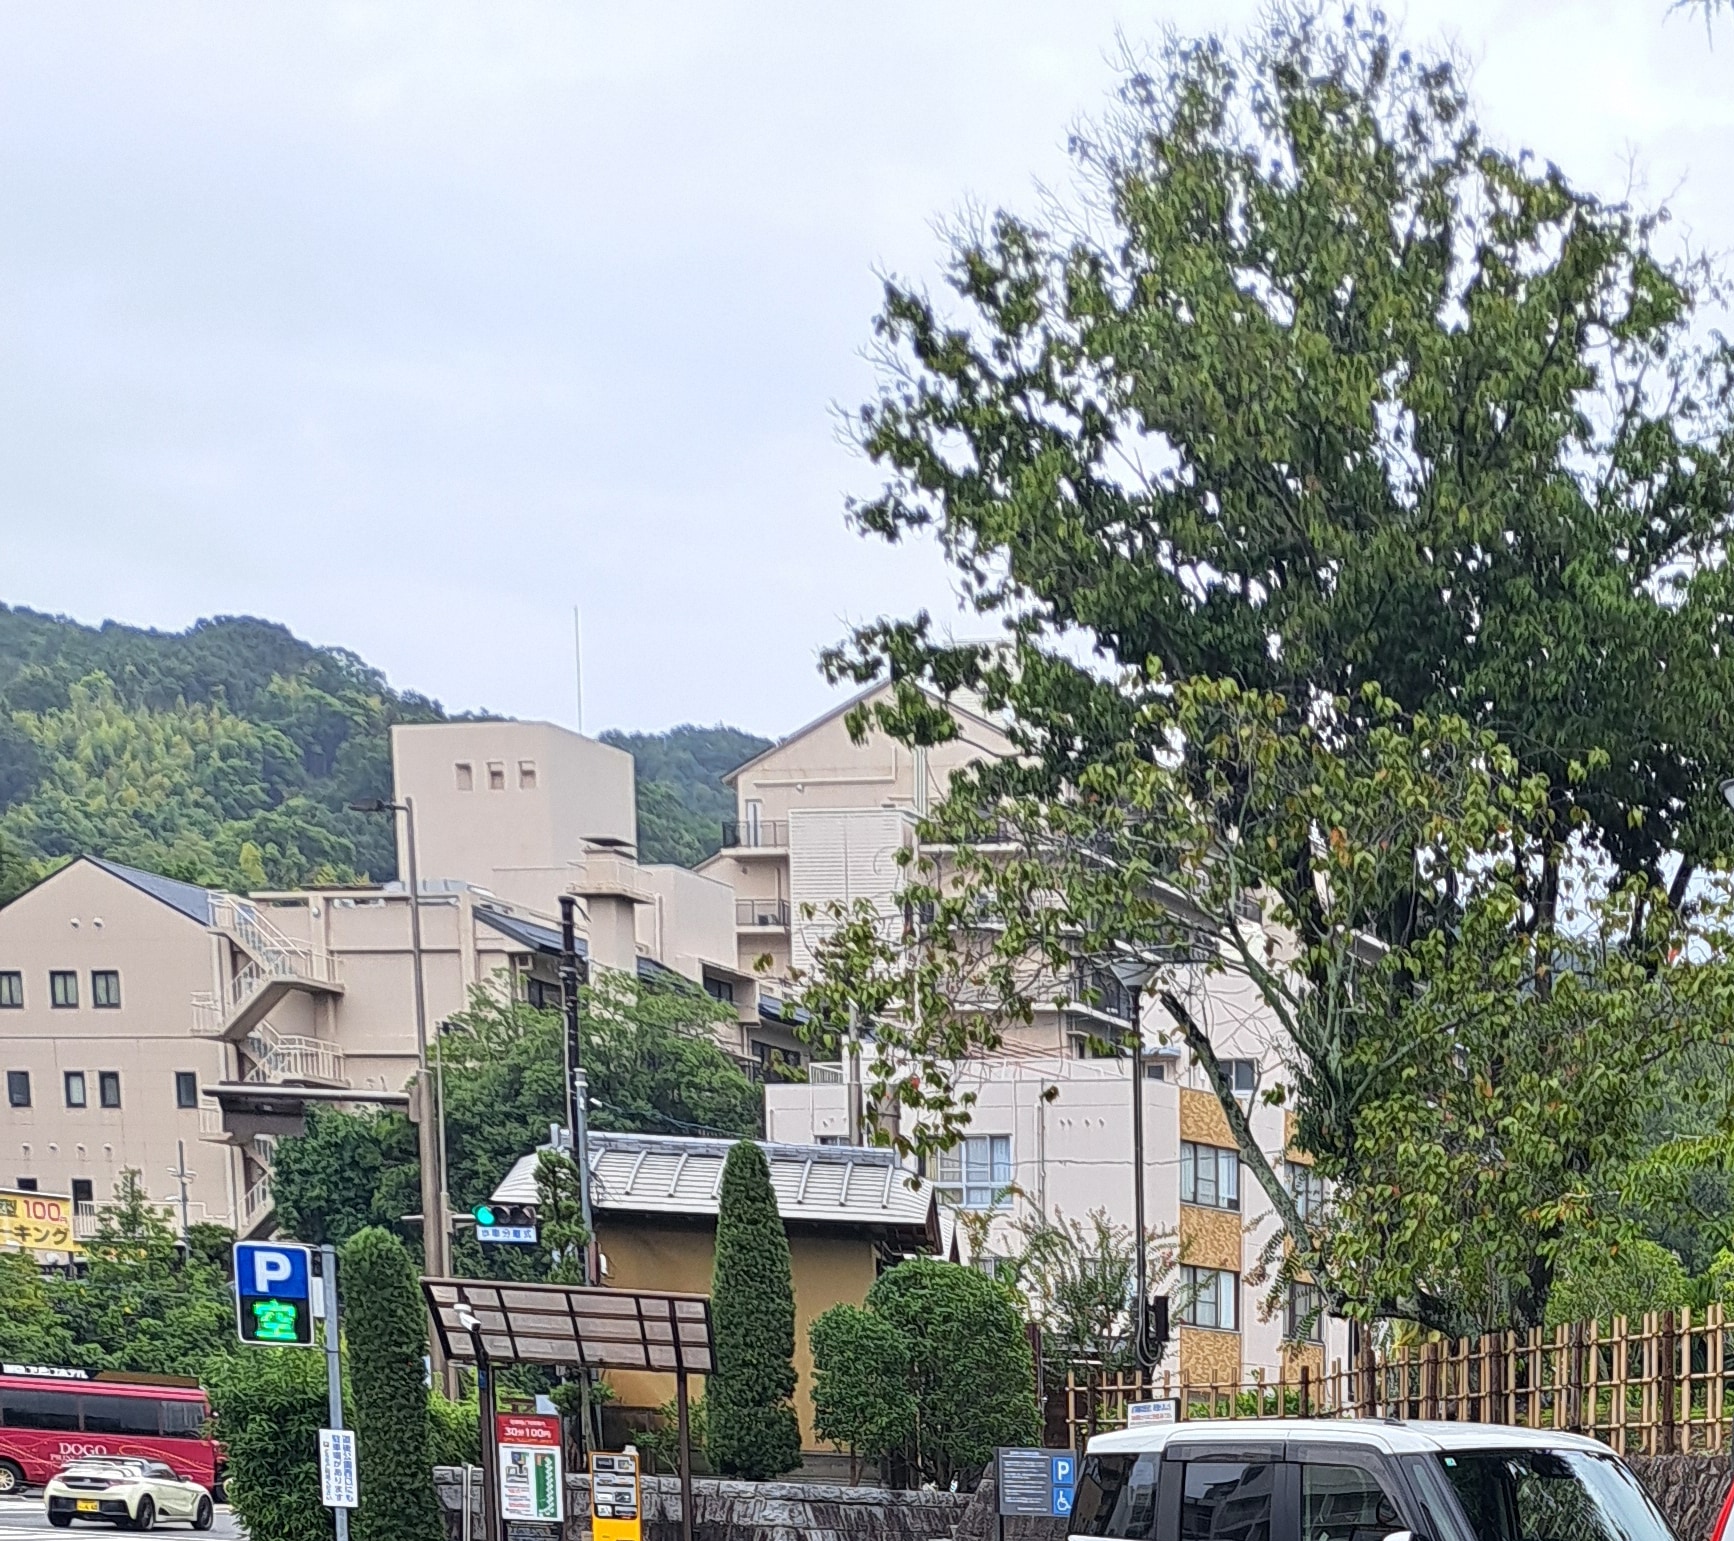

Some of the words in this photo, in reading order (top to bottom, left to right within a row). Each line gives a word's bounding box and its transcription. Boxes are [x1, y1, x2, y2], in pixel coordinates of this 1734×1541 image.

[254, 1251, 292, 1293] P
[59, 1442, 107, 1456] DOGO
[1057, 1460, 1069, 1481] P
